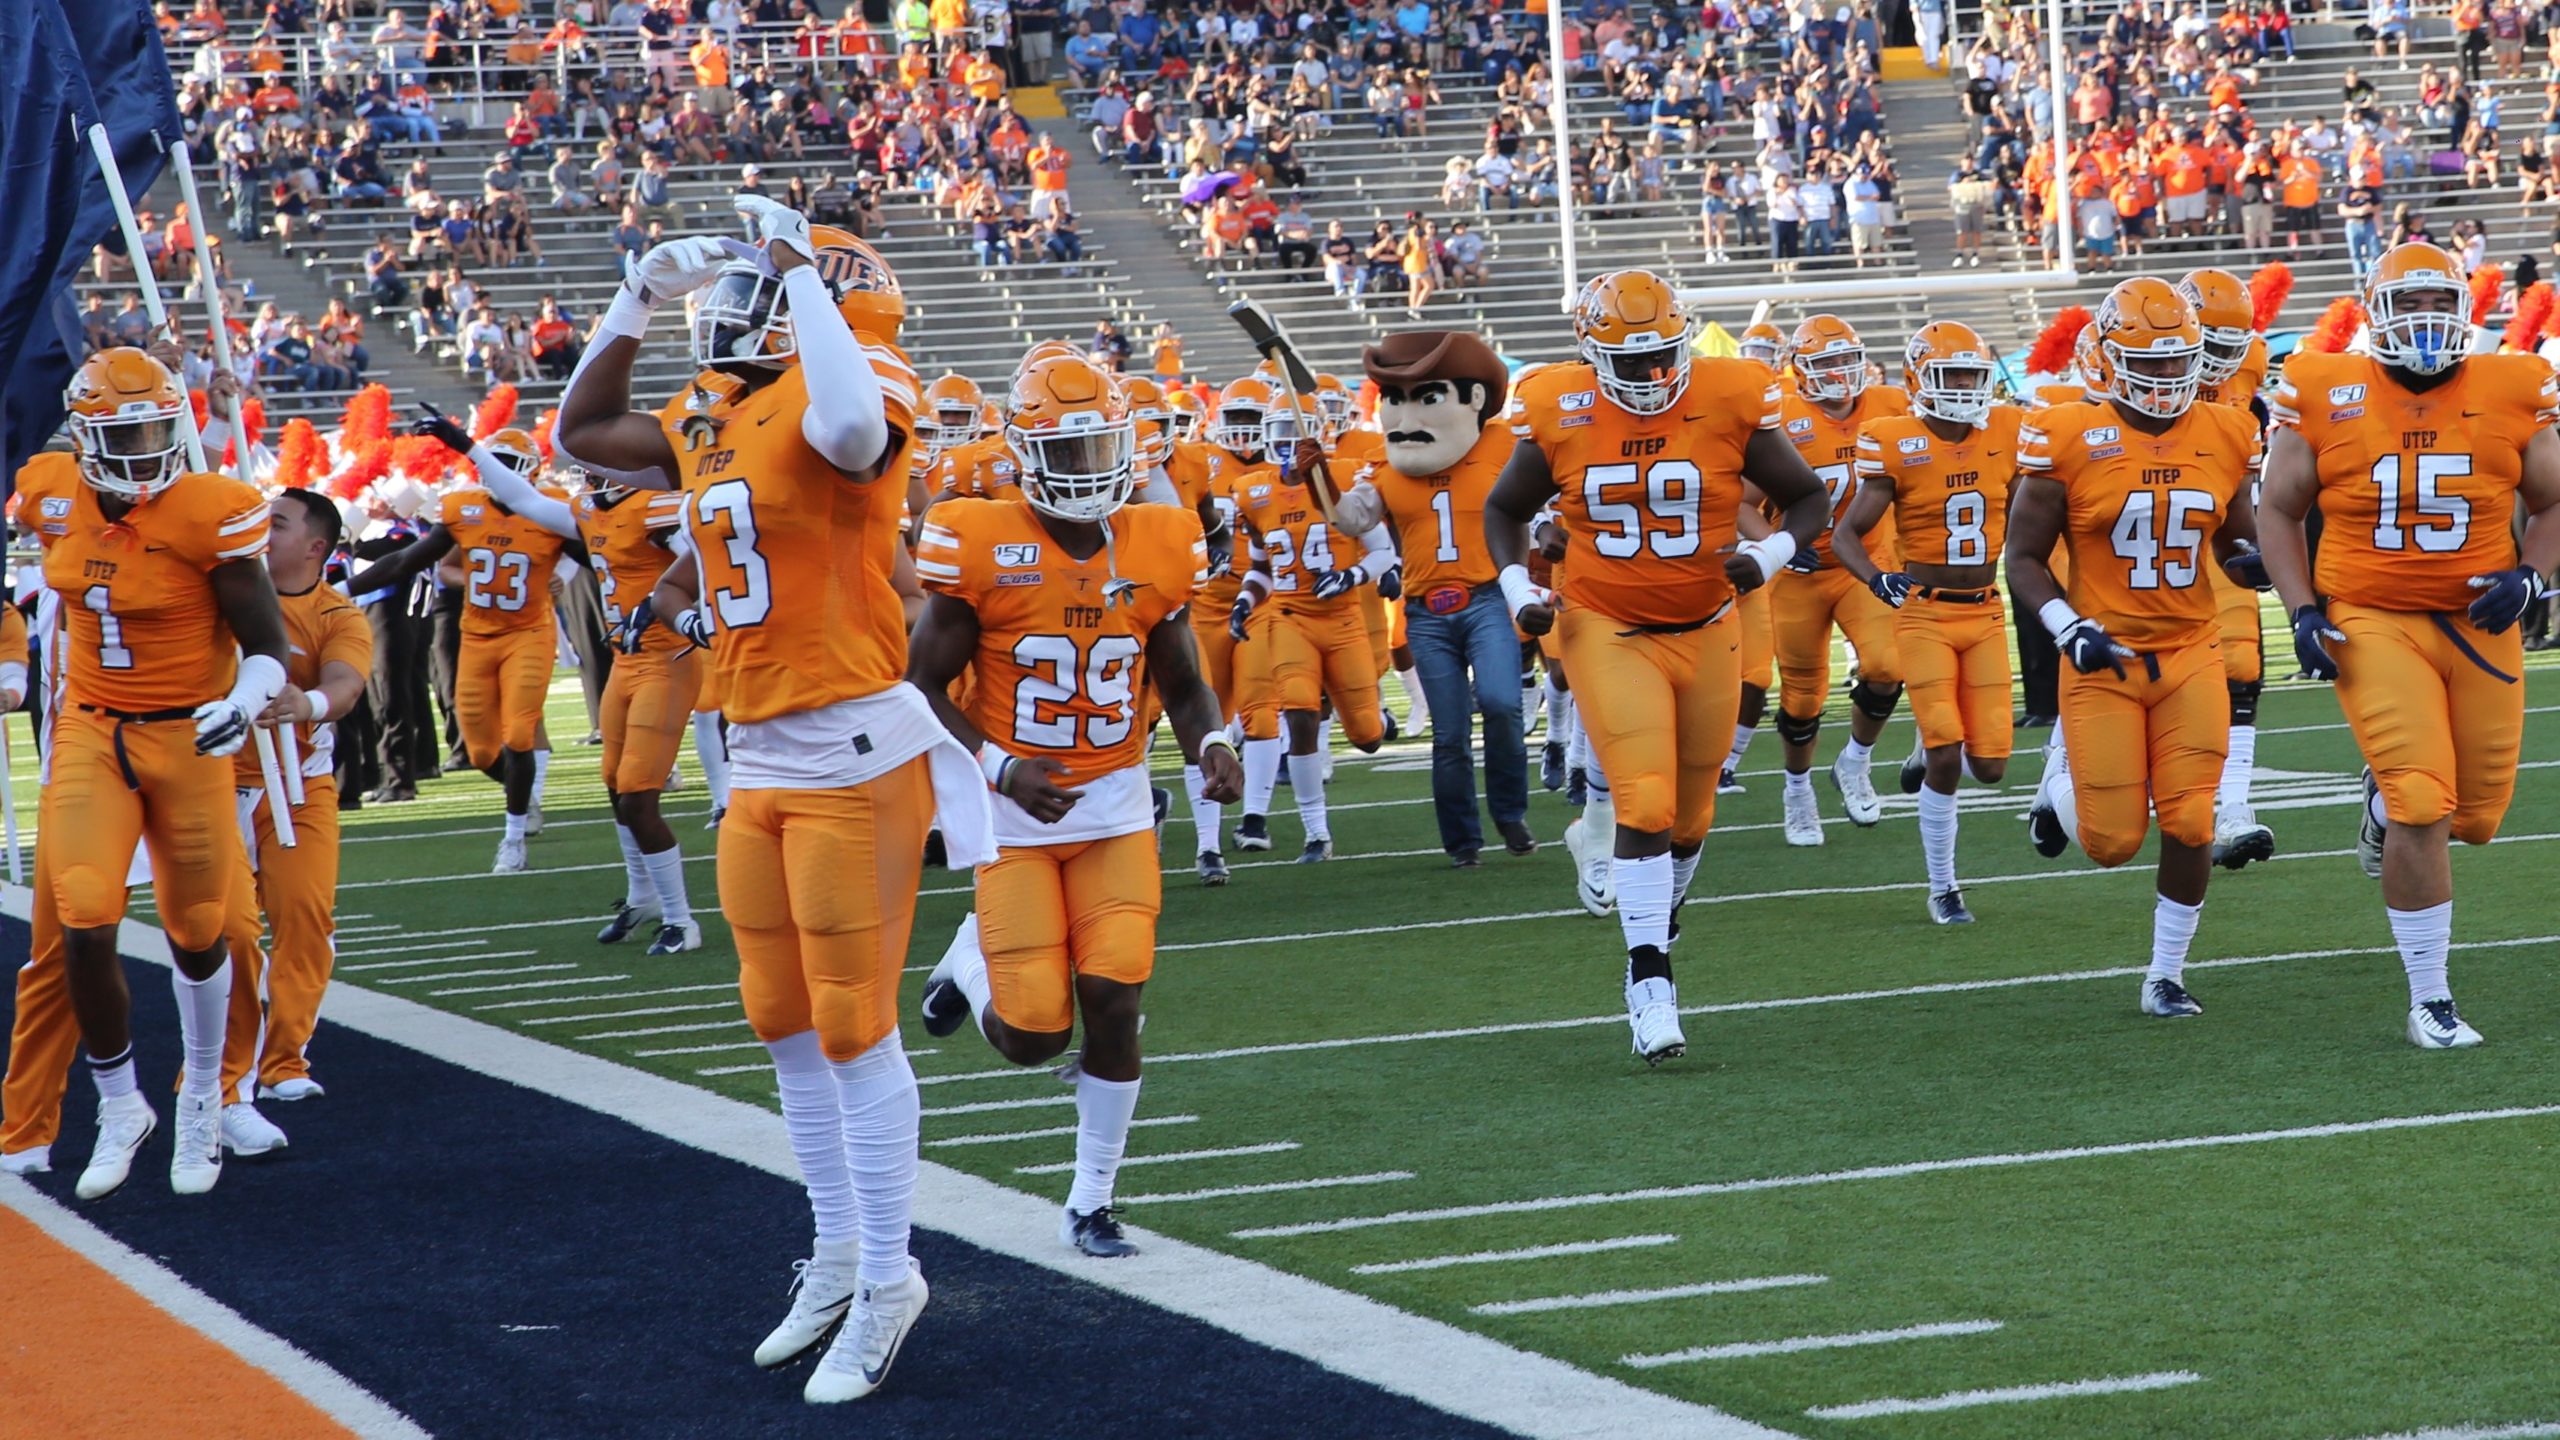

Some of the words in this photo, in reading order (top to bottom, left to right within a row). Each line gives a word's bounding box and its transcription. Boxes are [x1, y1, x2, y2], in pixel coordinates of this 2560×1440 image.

[1621, 437, 1666, 457] UTEP
[1835, 446, 1857, 459] UTE
[2402, 431, 2437, 449] UTEP
[695, 449, 736, 477] UTEP
[2142, 469, 2181, 485] UTEP
[1946, 471, 1979, 488] UTEP
[1280, 510, 1307, 524] UTEP
[1583, 459, 1702, 560] 59
[2371, 454, 2473, 553] 15
[1430, 489, 1460, 563] 1
[1945, 489, 1988, 566] 8
[2110, 489, 2215, 589] 45
[83, 558, 118, 581] UTEP
[995, 544, 1038, 567] 150
[1263, 522, 1336, 592] 24
[466, 547, 531, 612] 23
[83, 582, 134, 669] 1
[1064, 606, 1103, 629] UTEP
[1011, 633, 1142, 749] 29
